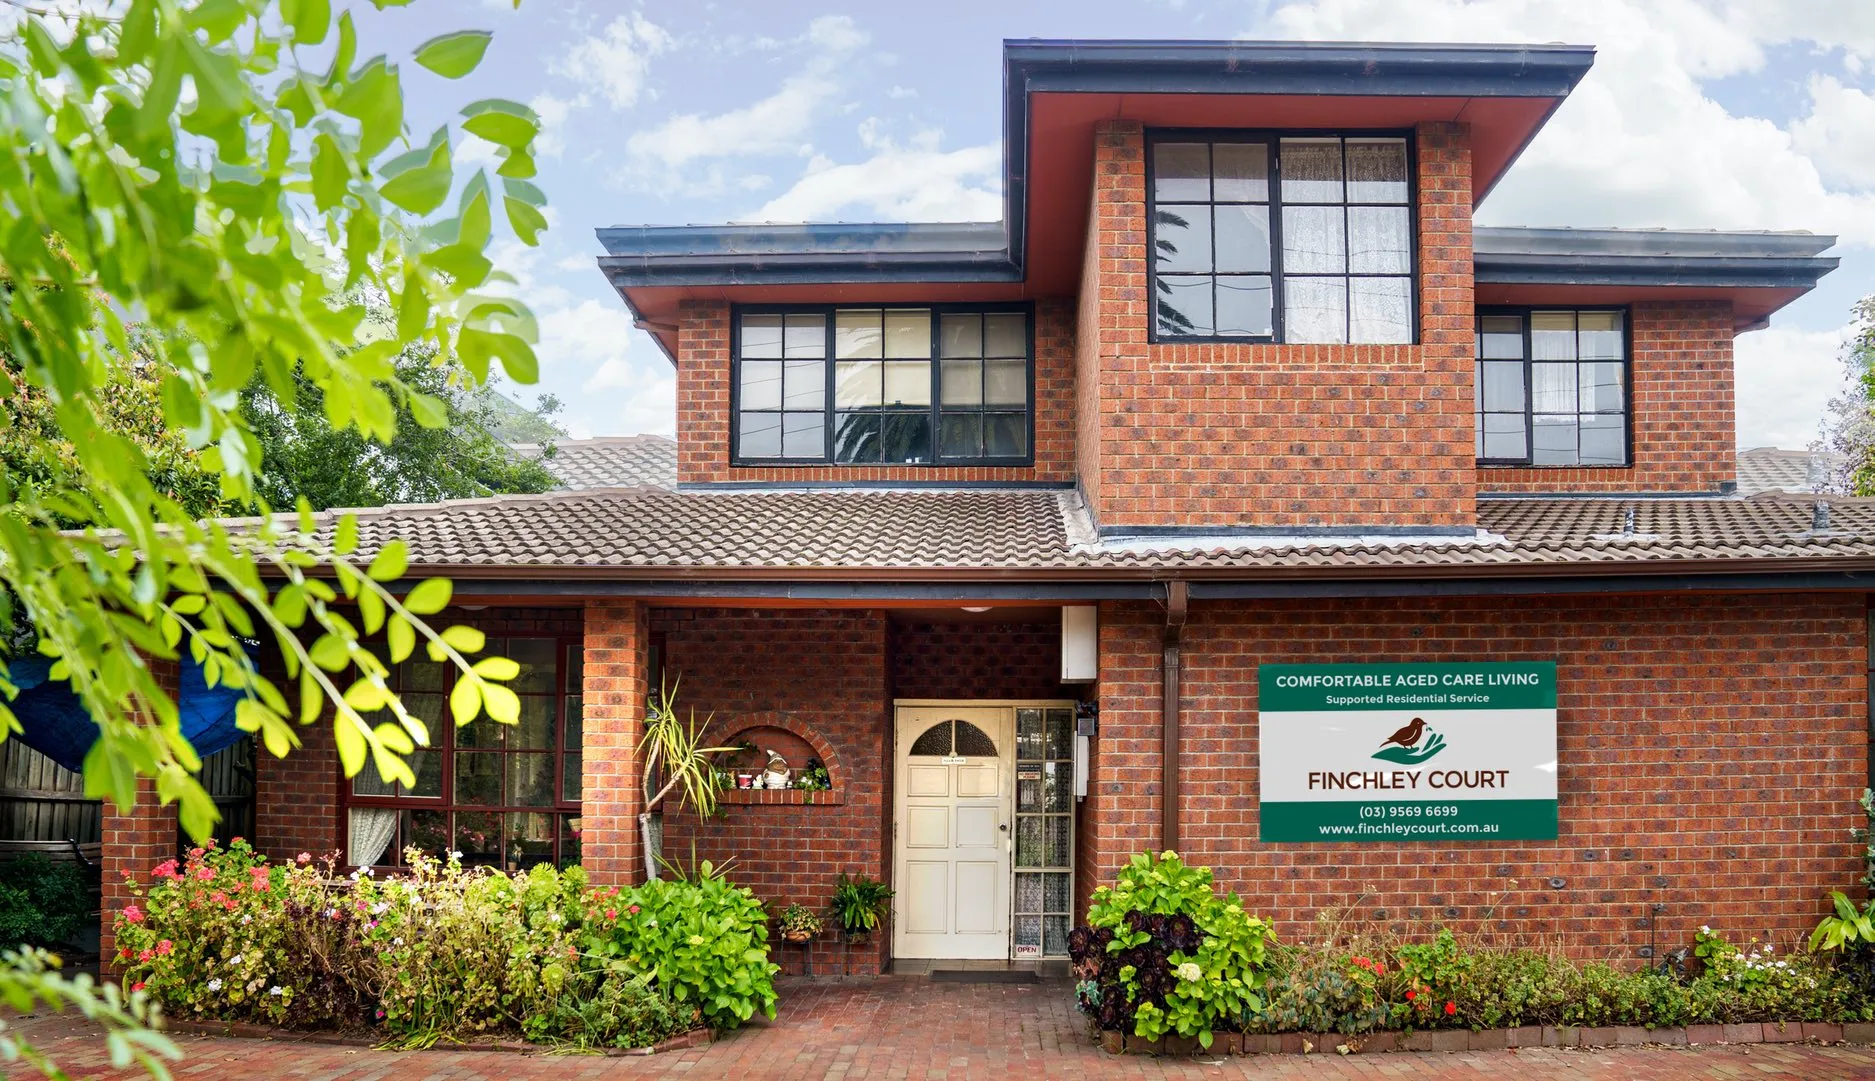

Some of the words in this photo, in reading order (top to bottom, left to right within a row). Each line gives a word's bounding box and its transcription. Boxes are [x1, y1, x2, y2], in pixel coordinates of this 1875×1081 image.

[1276, 674, 1391, 688] COMFORTABLE
[1395, 674, 1438, 687] AGED
[1442, 673, 1484, 686] CARE
[1488, 673, 1539, 686] LIVING
[1326, 694, 1384, 706] Supported
[1386, 694, 1447, 704] Residential
[1449, 693, 1490, 703] Service
[1308, 770, 1421, 790] FINCHLEY
[1428, 770, 1510, 789] COURT
[1359, 806, 1386, 819] (03)
[1389, 806, 1422, 817] 9569
[1425, 805, 1458, 817] 6699
[1319, 822, 1499, 836] www.finchleycourt.com.au
